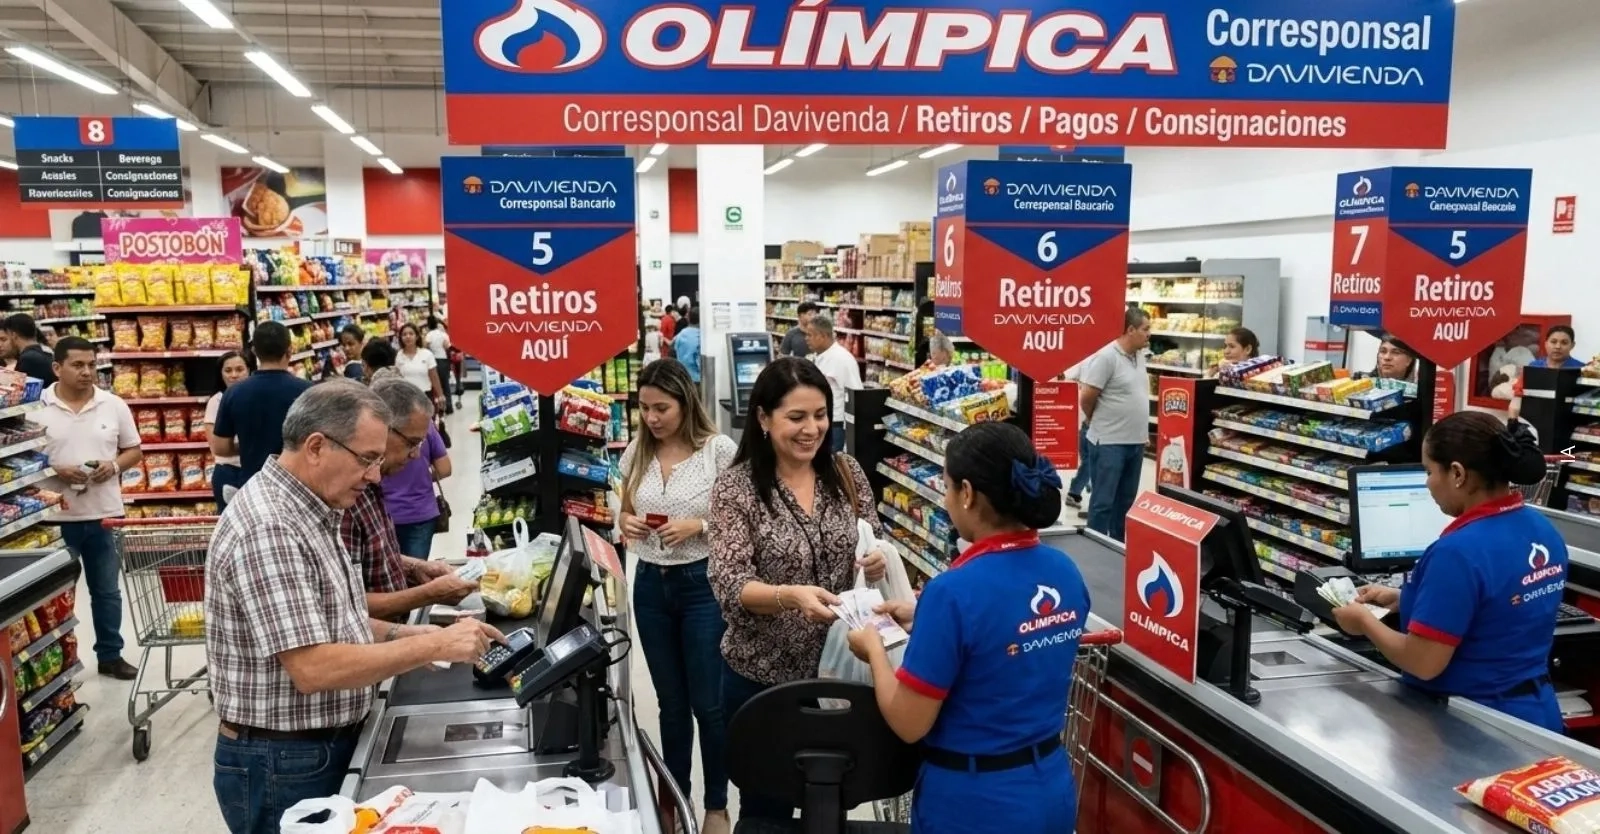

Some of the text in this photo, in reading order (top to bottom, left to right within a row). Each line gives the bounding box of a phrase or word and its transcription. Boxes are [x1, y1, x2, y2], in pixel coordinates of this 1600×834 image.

[622, 0, 1178, 74] OLÍMPICA
[1206, 8, 1431, 56] Corresponsal
[1246, 63, 1424, 86] DAVIVIENDA
[88, 120, 105, 142] 8
[563, 103, 743, 138] Corresponsal
[753, 104, 889, 132] Davivenda
[917, 105, 1012, 133] Retiros
[1039, 106, 1119, 139] Pagos
[1145, 107, 1347, 142] Consignaciones
[41, 153, 74, 164] Snacks
[489, 180, 618, 194] DAVIVIENDA
[1006, 183, 1117, 197] DAVIVIENDA
[1424, 186, 1520, 199] DAVIVIENDA
[500, 197, 616, 212] Corresponsal Bancario
[120, 226, 226, 258] POSTOBÓN
[532, 231, 554, 266] 5
[944, 224, 955, 267] 6
[1037, 231, 1058, 263] 6
[1350, 225, 1370, 265] 7
[1450, 230, 1467, 260] 5
[1000, 278, 1092, 309] Retiros
[1333, 272, 1381, 295] Retiros
[1415, 274, 1495, 301] Retiros
[489, 282, 598, 316] Retiros
[1410, 306, 1496, 318] DAVIVIENDA
[485, 320, 603, 335] DAVIVIENDA
[993, 313, 1095, 326] DAVIVIENDA
[1433, 320, 1469, 341] AQUÍ
[521, 334, 569, 362] AQUÍ
[1022, 328, 1065, 352] AQUÍ
[1129, 610, 1190, 652] OLÍMPICA
